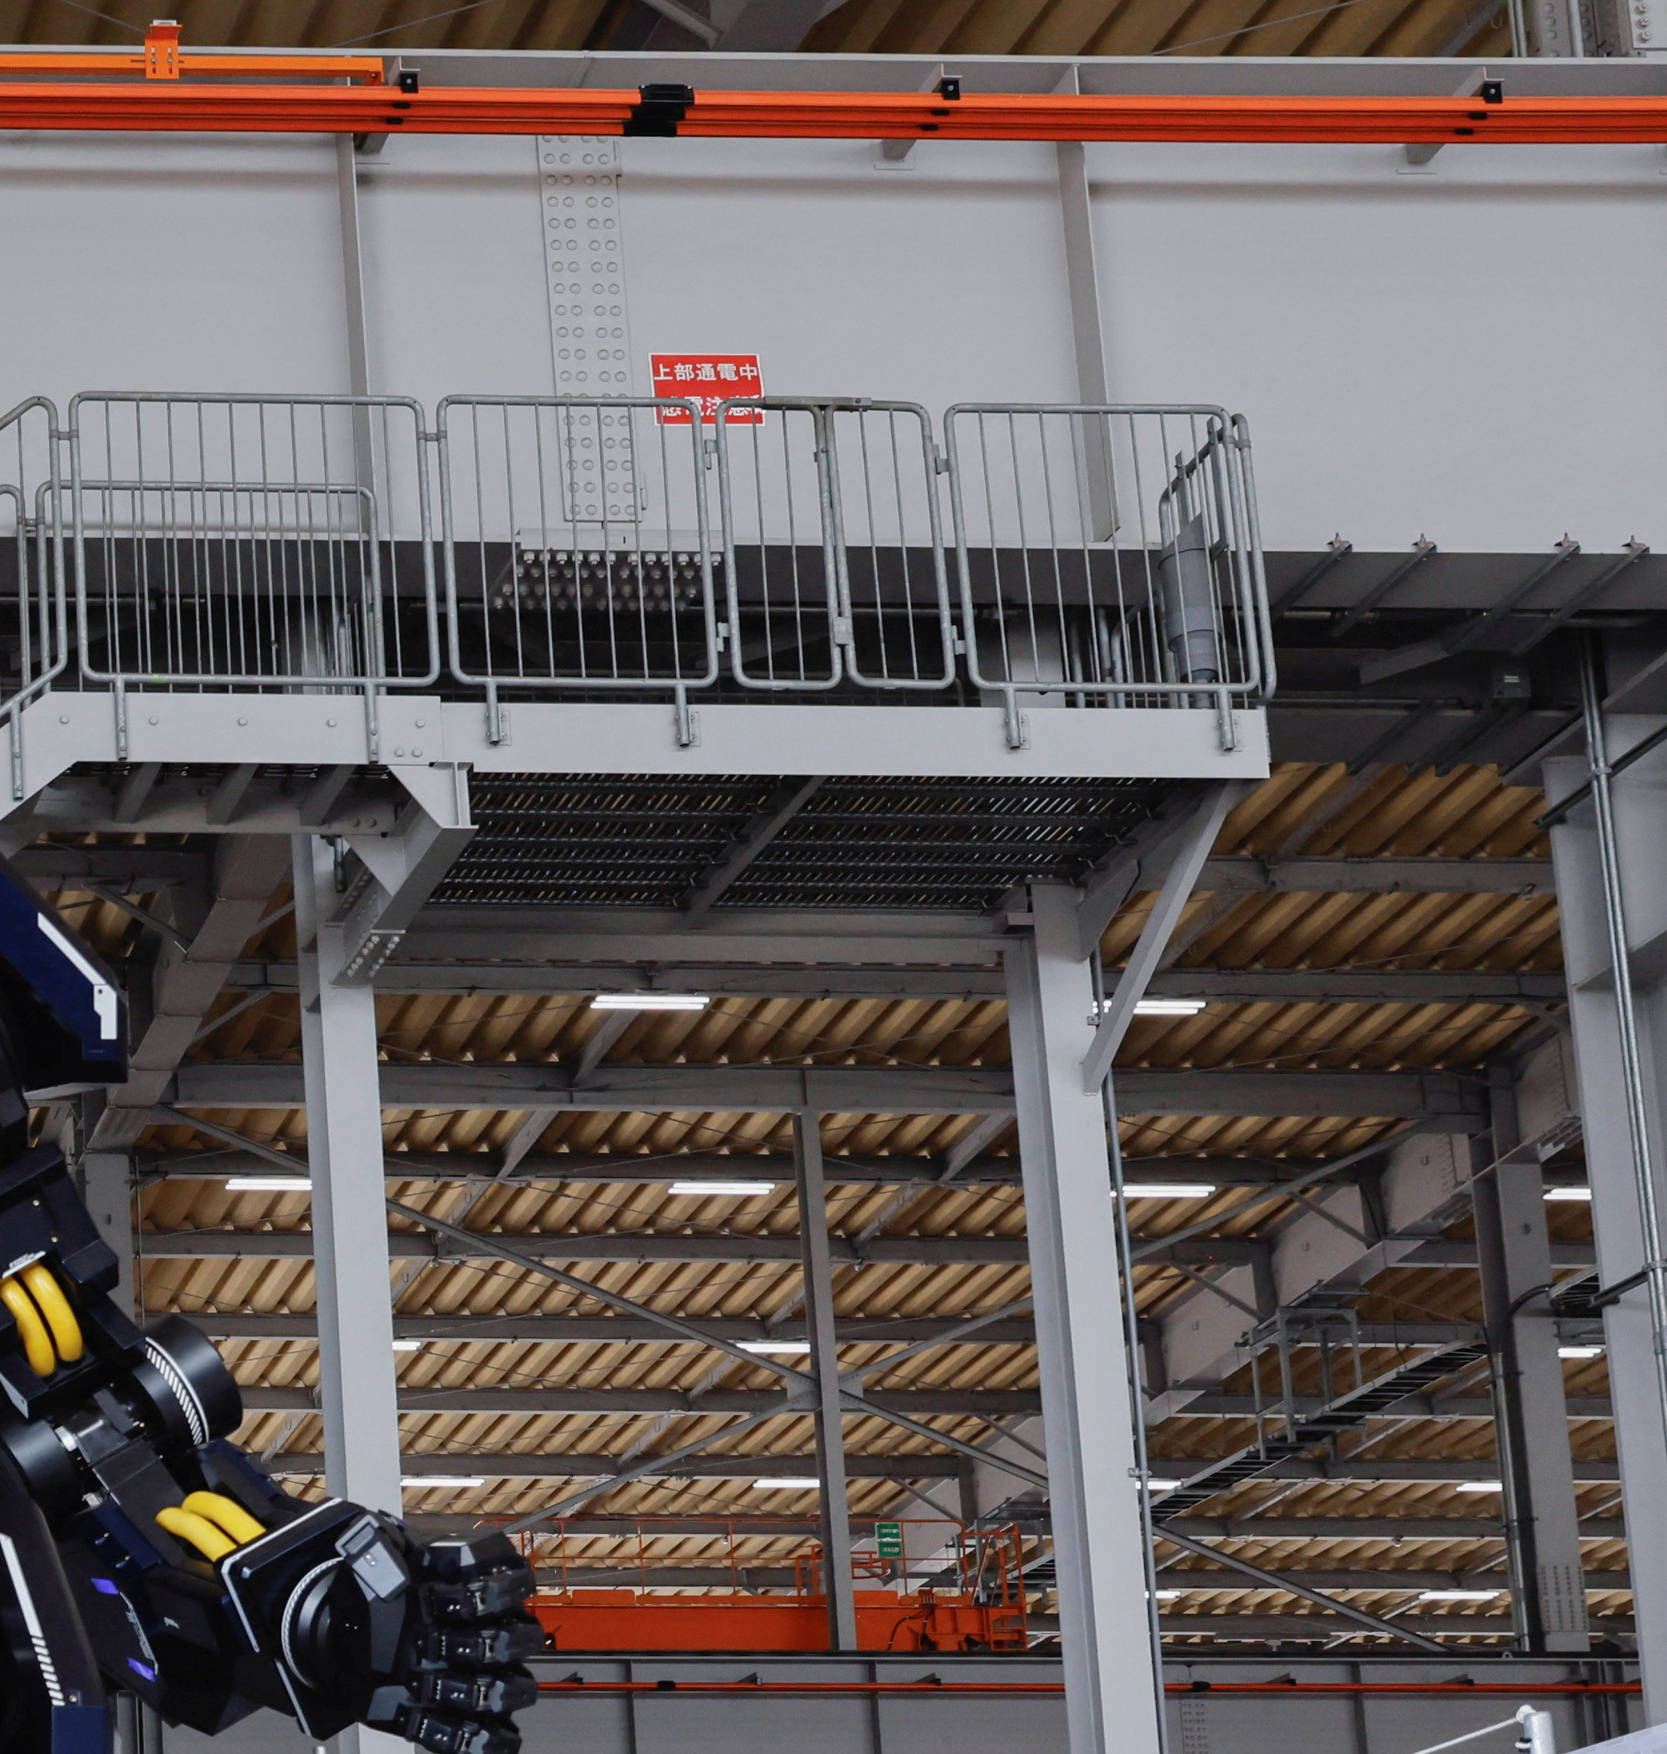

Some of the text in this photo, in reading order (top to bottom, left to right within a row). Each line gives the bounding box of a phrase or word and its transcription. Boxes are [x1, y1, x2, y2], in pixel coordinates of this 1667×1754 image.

[653, 363, 758, 381] 上部通電中
